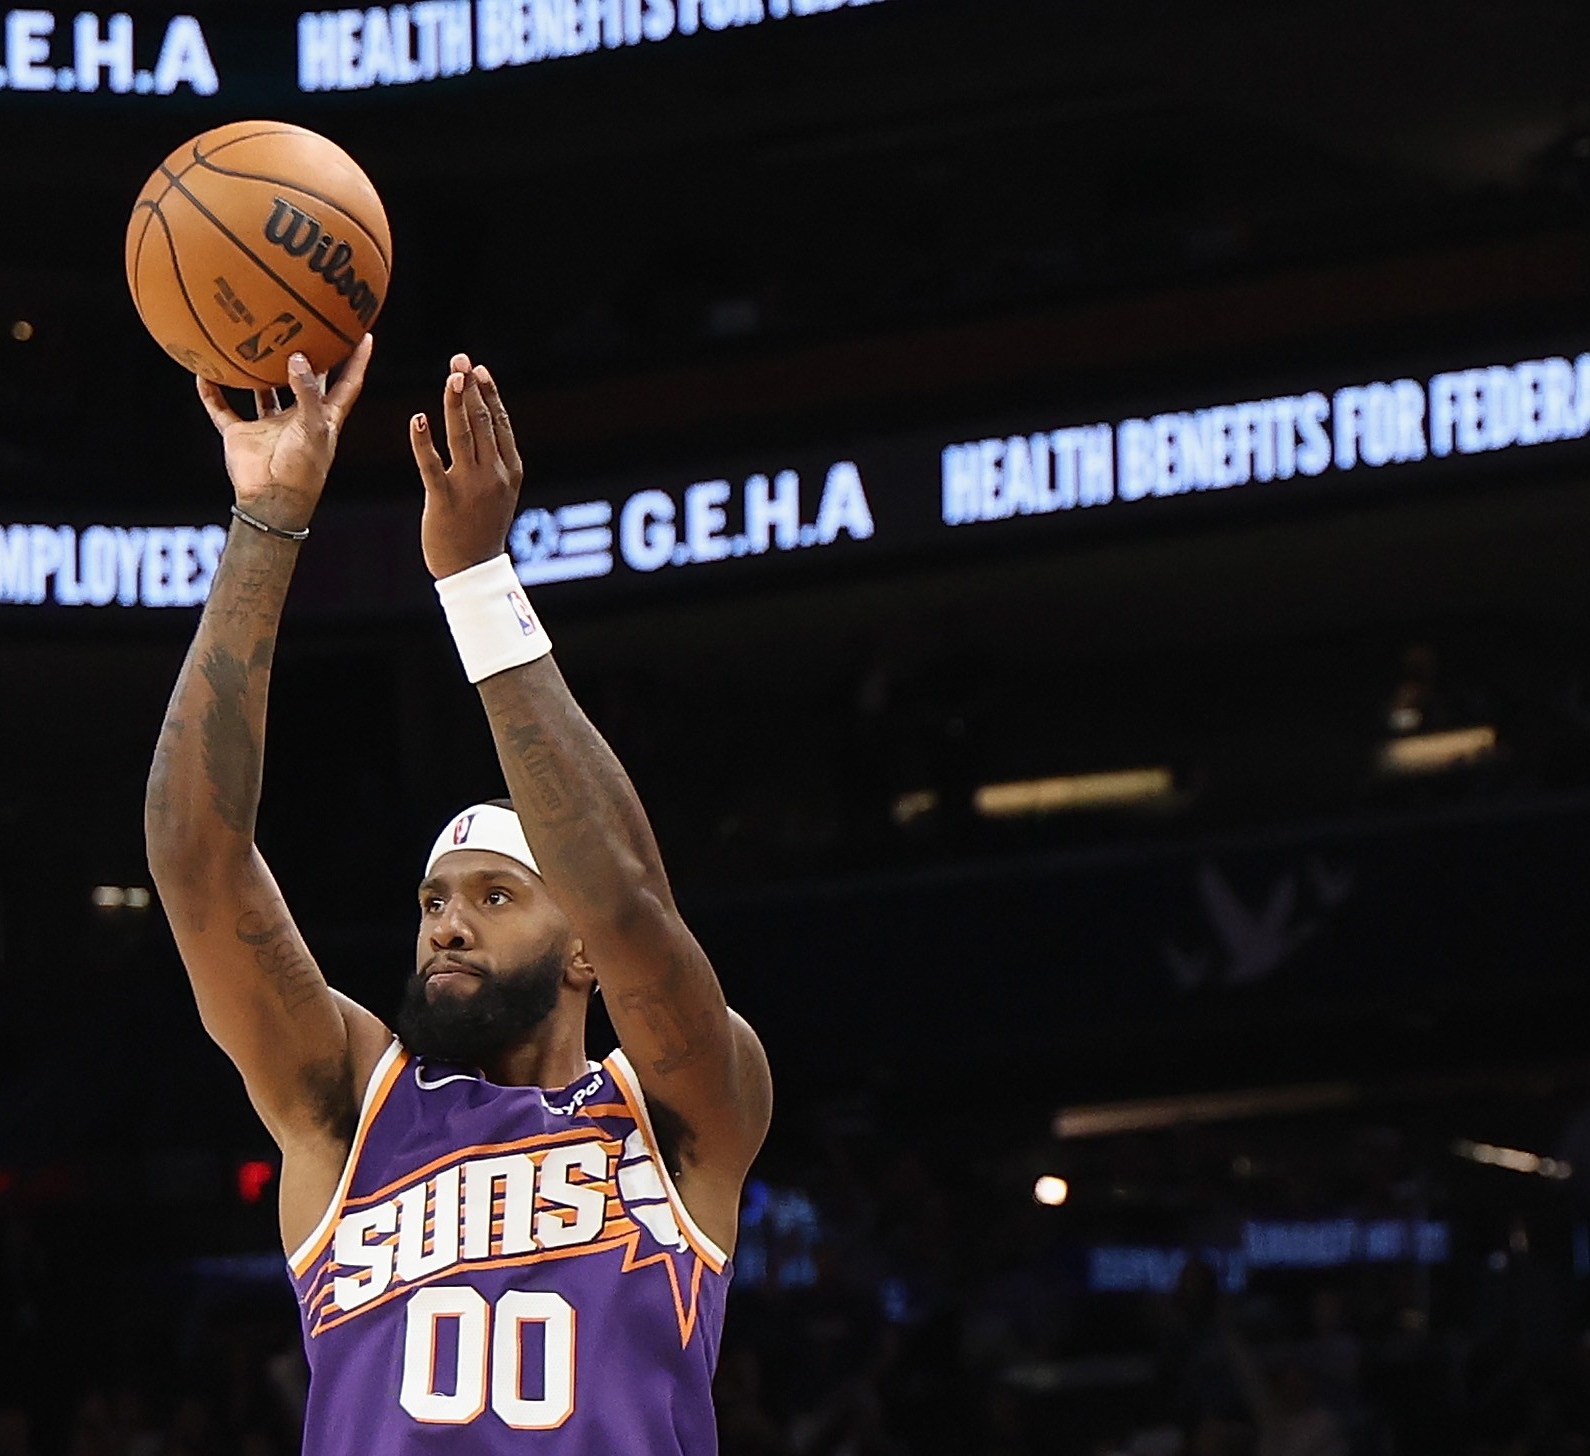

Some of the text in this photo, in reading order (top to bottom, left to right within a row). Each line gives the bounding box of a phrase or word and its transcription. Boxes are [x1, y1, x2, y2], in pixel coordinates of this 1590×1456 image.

[298, 8, 473, 92] HEALTH
[265, 196, 377, 323] Wilson
[619, 460, 875, 572] G.E.H.A
[941, 422, 1113, 526] HEALTH
[1117, 391, 1330, 501] BENEFITS
[1333, 378, 1427, 471] FOR
[333, 1142, 609, 1312] SUNS
[399, 1286, 577, 1430] 00
